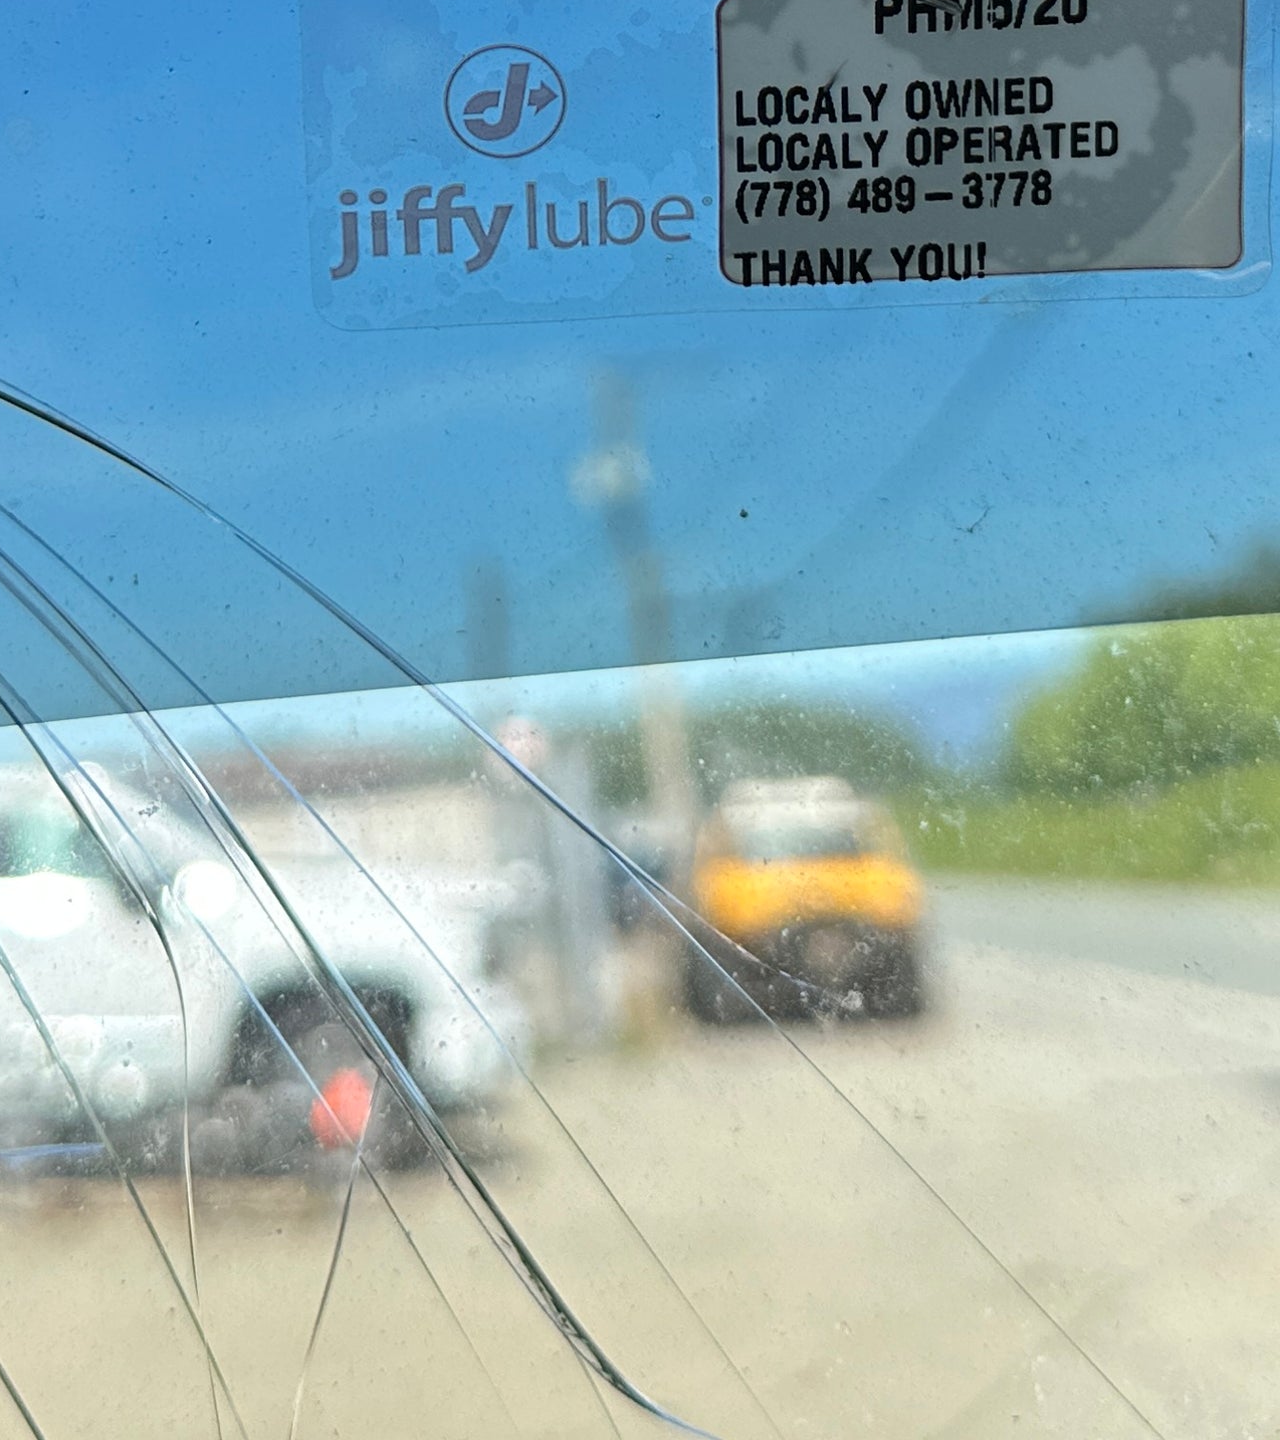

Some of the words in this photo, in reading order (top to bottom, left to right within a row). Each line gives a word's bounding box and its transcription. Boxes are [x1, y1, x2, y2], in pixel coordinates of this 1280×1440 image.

[734, 83, 888, 129] LOCALY
[904, 75, 1055, 121] OWNED
[735, 129, 889, 174] LOCALY
[905, 120, 1120, 167] OPERATED
[734, 177, 832, 225] (778)
[733, 246, 874, 289] THANK
[889, 241, 988, 284] YOU!
